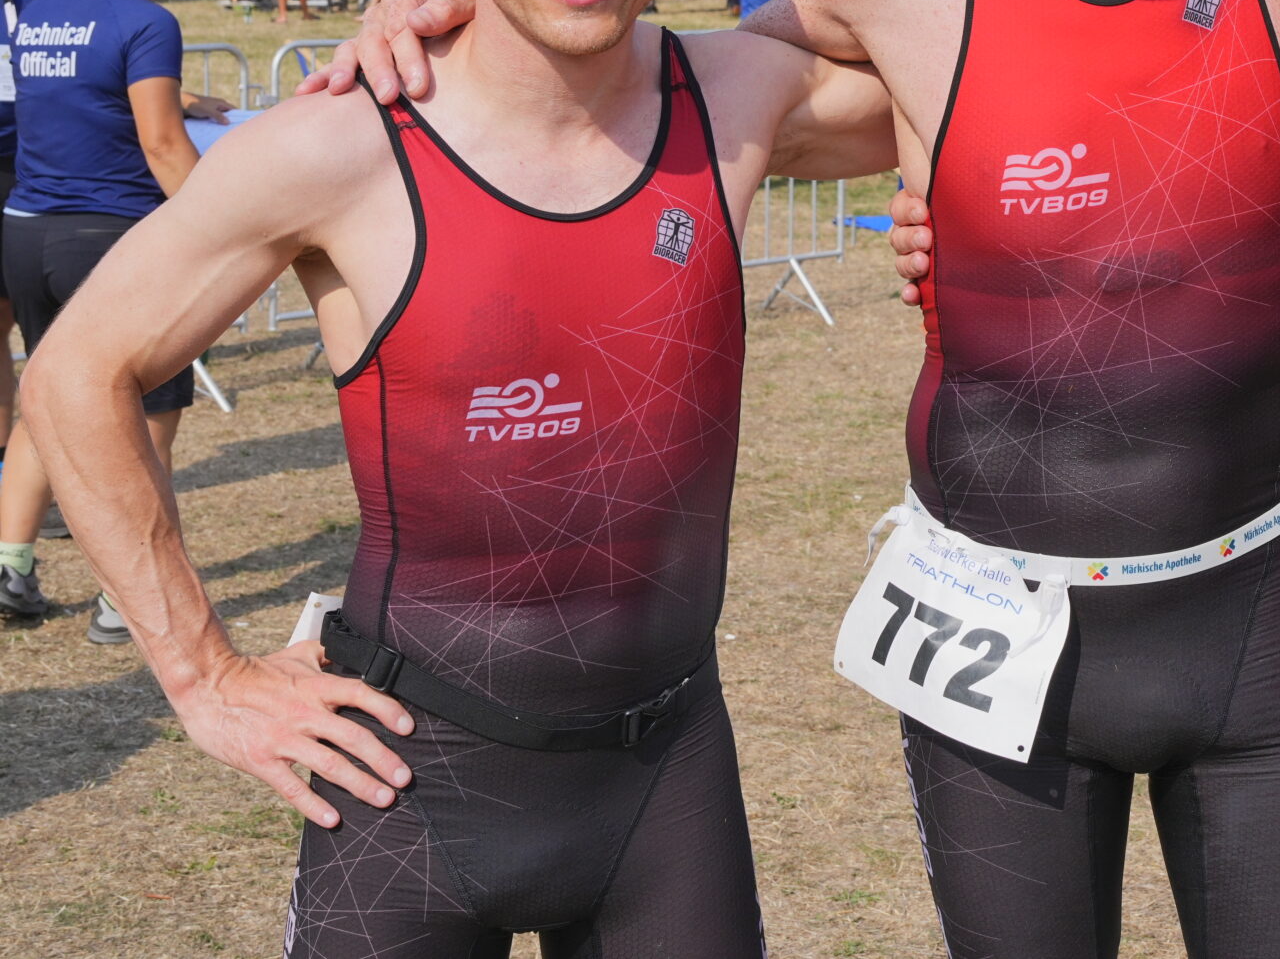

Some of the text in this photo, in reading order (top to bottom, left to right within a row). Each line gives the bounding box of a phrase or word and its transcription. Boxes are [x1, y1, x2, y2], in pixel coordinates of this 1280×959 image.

[1183, 9, 1214, 30] BIORACER
[15, 21, 96, 46] Technical
[19, 50, 77, 77] Official
[1000, 188, 1109, 216] TVB09
[653, 245, 687, 266] BIORACER
[465, 417, 581, 442] TVB09
[1244, 520, 1274, 542] Märkische
[977, 564, 1012, 586] Halle
[1121, 553, 1202, 574] Märkische Apotheke
[907, 552, 1024, 616] TRIATHLON
[871, 581, 1011, 713] 772
